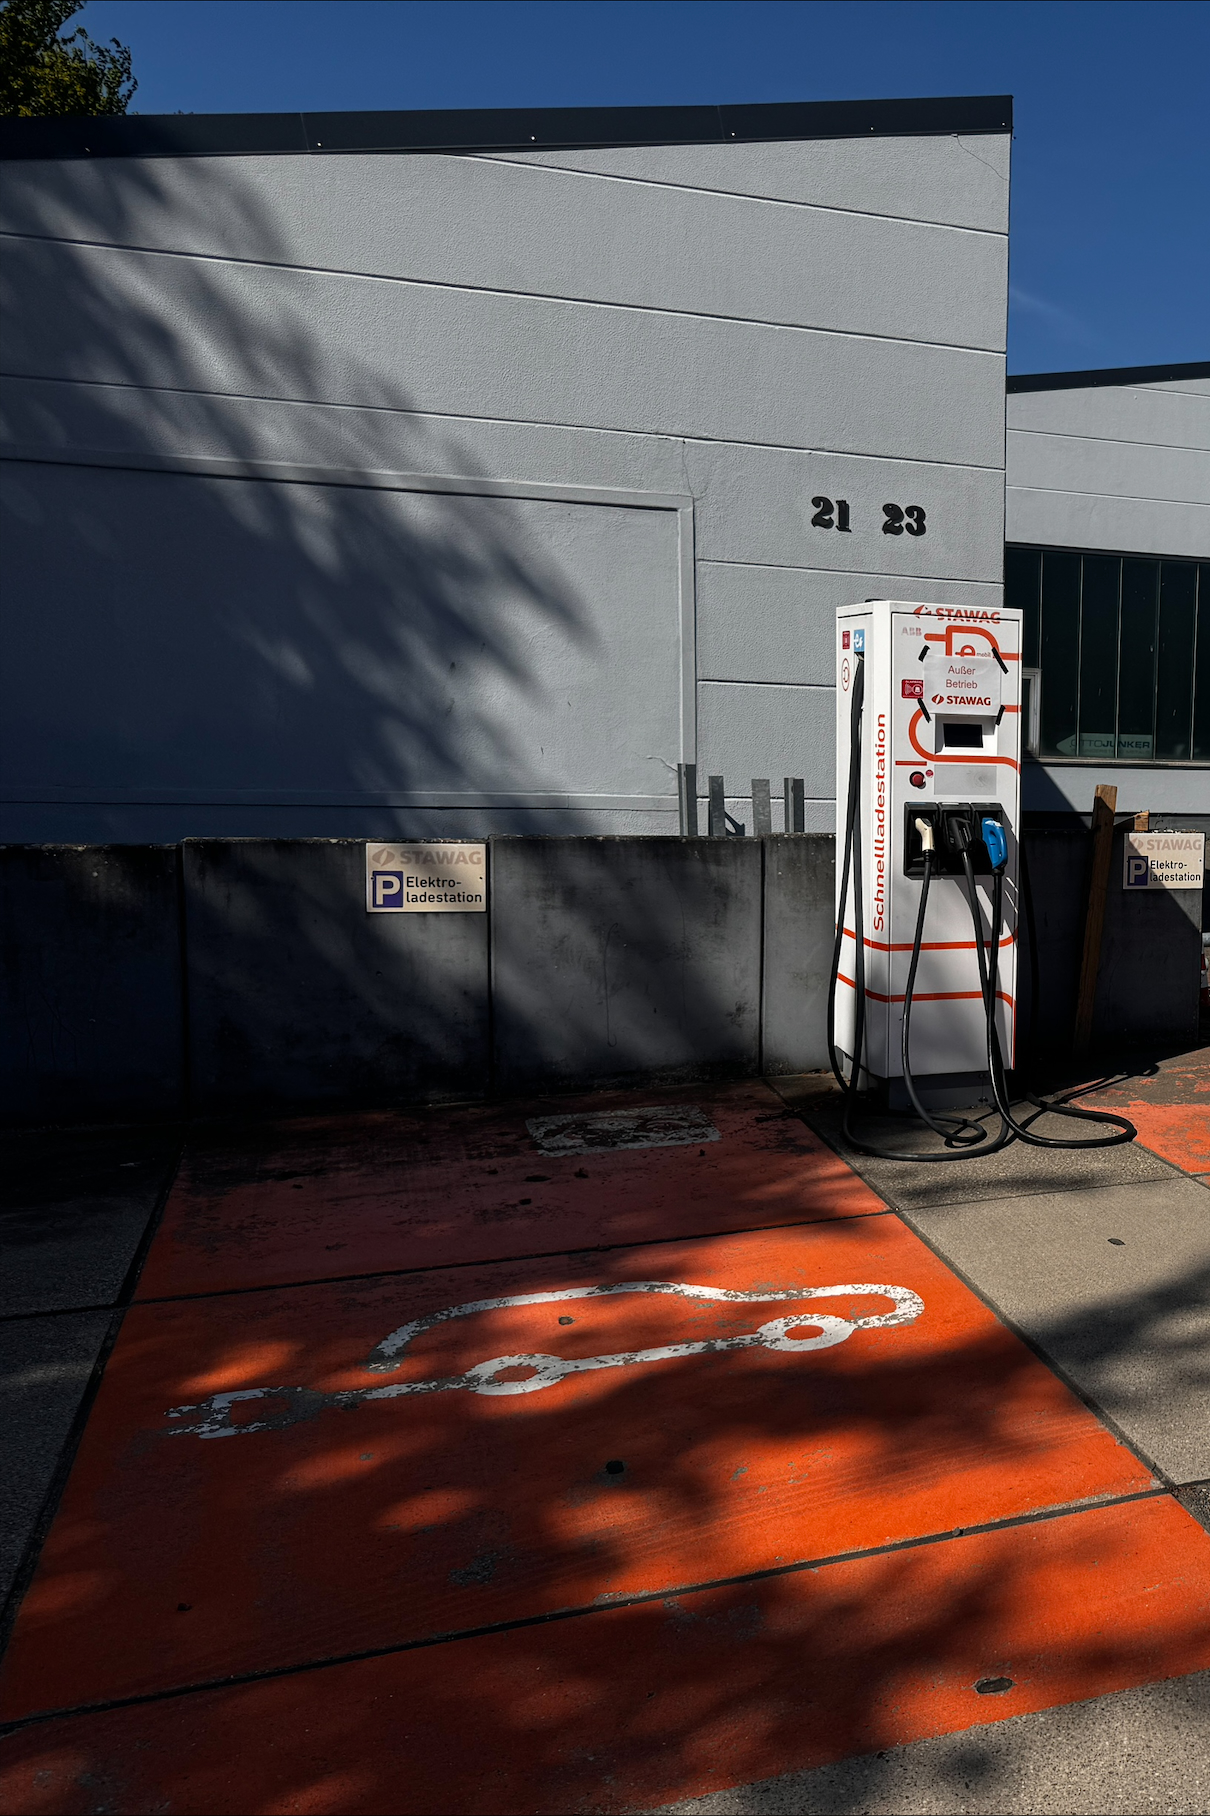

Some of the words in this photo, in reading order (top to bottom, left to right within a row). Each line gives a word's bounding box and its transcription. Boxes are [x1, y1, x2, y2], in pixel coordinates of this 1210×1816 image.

[810, 495, 852, 533] 21
[882, 503, 927, 536] 23
[935, 607, 1001, 625] STAWAG
[901, 627, 923, 637] ABB
[948, 664, 976, 676] Außer
[945, 679, 978, 690] Betrieb
[946, 695, 991, 706] STAWAG
[873, 713, 886, 932] Schnellladestation
[1146, 838, 1202, 851] STAWAG
[400, 850, 482, 865] STAWAG
[1150, 860, 1188, 870] Elektro-
[1129, 859, 1147, 884] P
[1150, 871, 1201, 882] ladestation
[406, 876, 461, 888] Elektro-
[375, 874, 401, 905] P
[406, 891, 482, 903] ladestation
